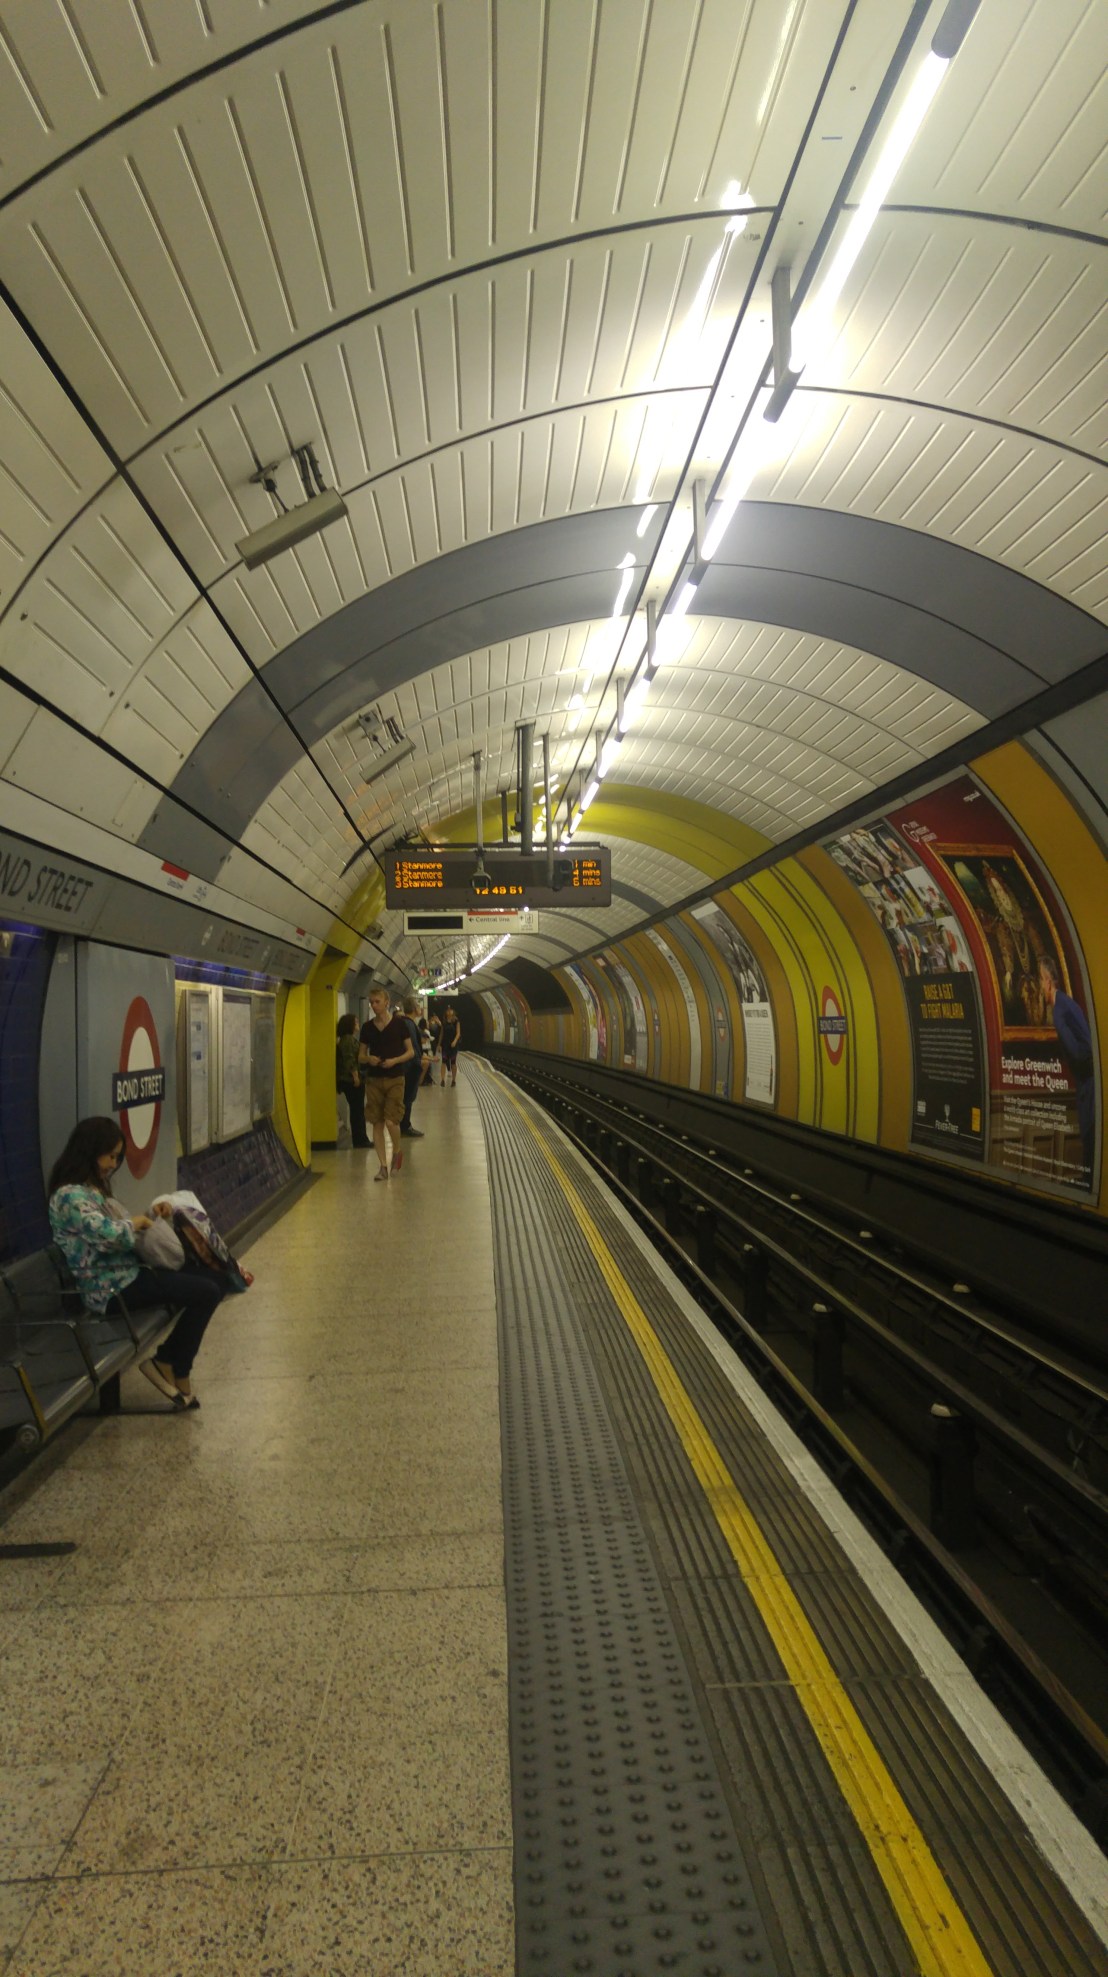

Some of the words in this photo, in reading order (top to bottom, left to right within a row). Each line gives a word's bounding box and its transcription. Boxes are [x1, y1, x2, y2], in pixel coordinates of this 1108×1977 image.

[395, 861, 400, 870] 1
[402, 861, 443, 870] Stanmore
[574, 860, 579, 868] 1
[582, 860, 597, 868] min
[0, 850, 31, 897] ND
[27, 865, 94, 914] STREET
[395, 870, 401, 878] 2
[402, 869, 443, 879] Stanmore
[572, 869, 579, 877] 4
[582, 869, 601, 877] mins
[395, 878, 402, 889] 3
[402, 879, 443, 889] Stanmore
[582, 877, 602, 887] mins
[920, 1003, 928, 1019] TO
[928, 1003, 942, 1019] FIGHT
[941, 1003, 965, 1019] MALARIA
[820, 1019, 832, 1031] BOND
[832, 1019, 846, 1031] STREET
[1001, 1055, 1024, 1072] Explore
[1024, 1057, 1062, 1074] Greenwich
[117, 1078, 139, 1103] BOND
[140, 1074, 163, 1098] STREET
[1002, 1071, 1014, 1084] and
[1014, 1074, 1031, 1086] meet
[1032, 1073, 1045, 1088] the
[1045, 1075, 1069, 1093] Queen
